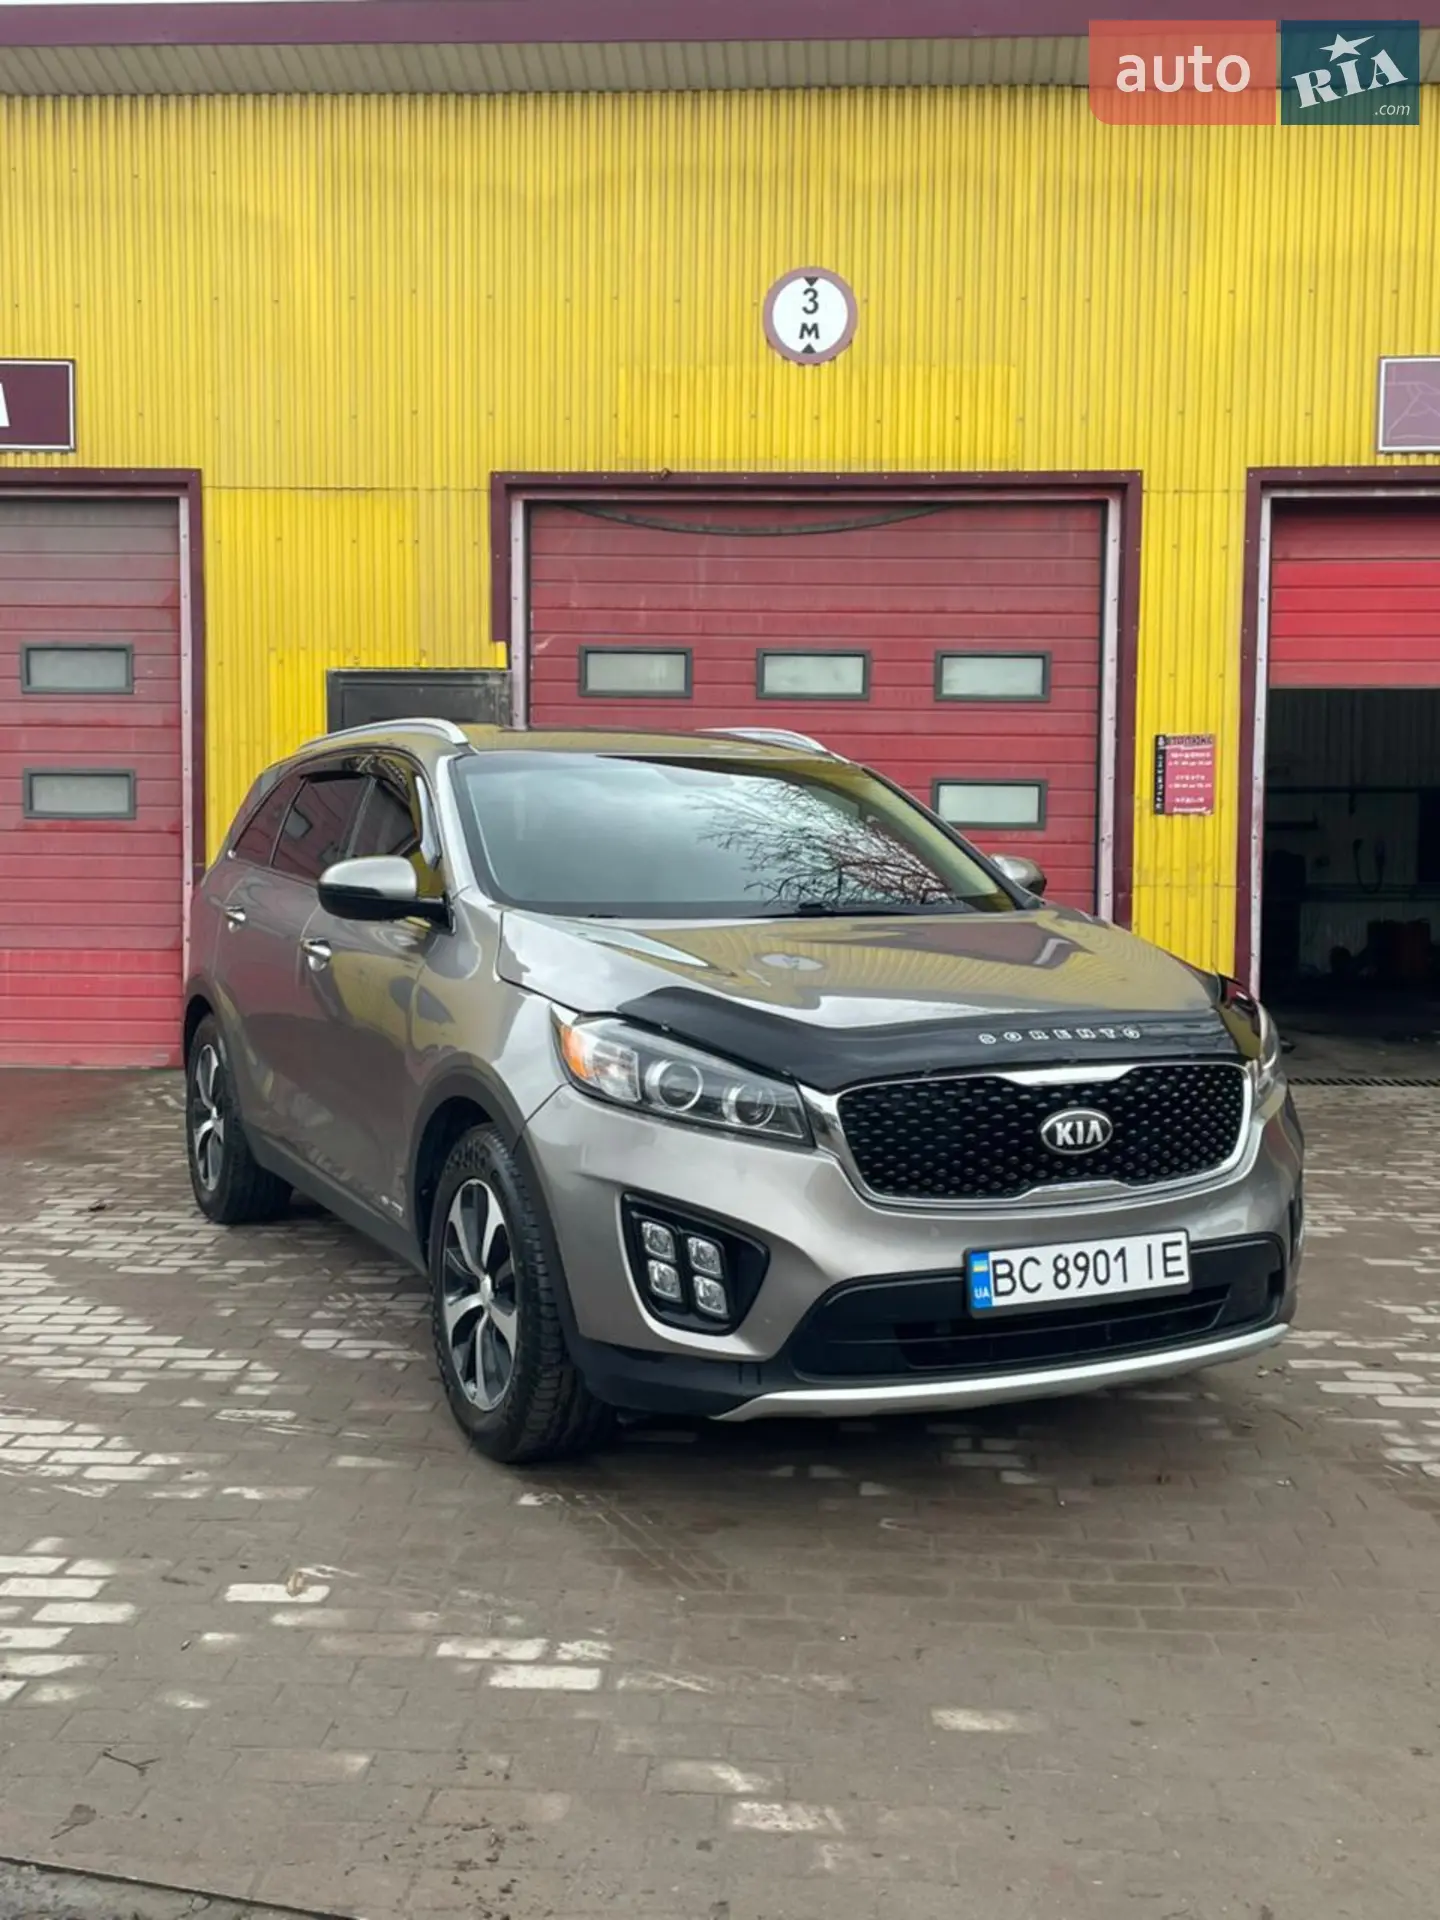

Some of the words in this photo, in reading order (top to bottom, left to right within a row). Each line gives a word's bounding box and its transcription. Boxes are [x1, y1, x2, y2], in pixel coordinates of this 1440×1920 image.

[802, 287, 819, 315] 3
[1056, 1120, 1103, 1146] KIA
[992, 1257, 1042, 1297] BC
[1052, 1247, 1128, 1290] 8901
[1147, 1240, 1185, 1281] IE
[975, 1288, 990, 1299] UA
